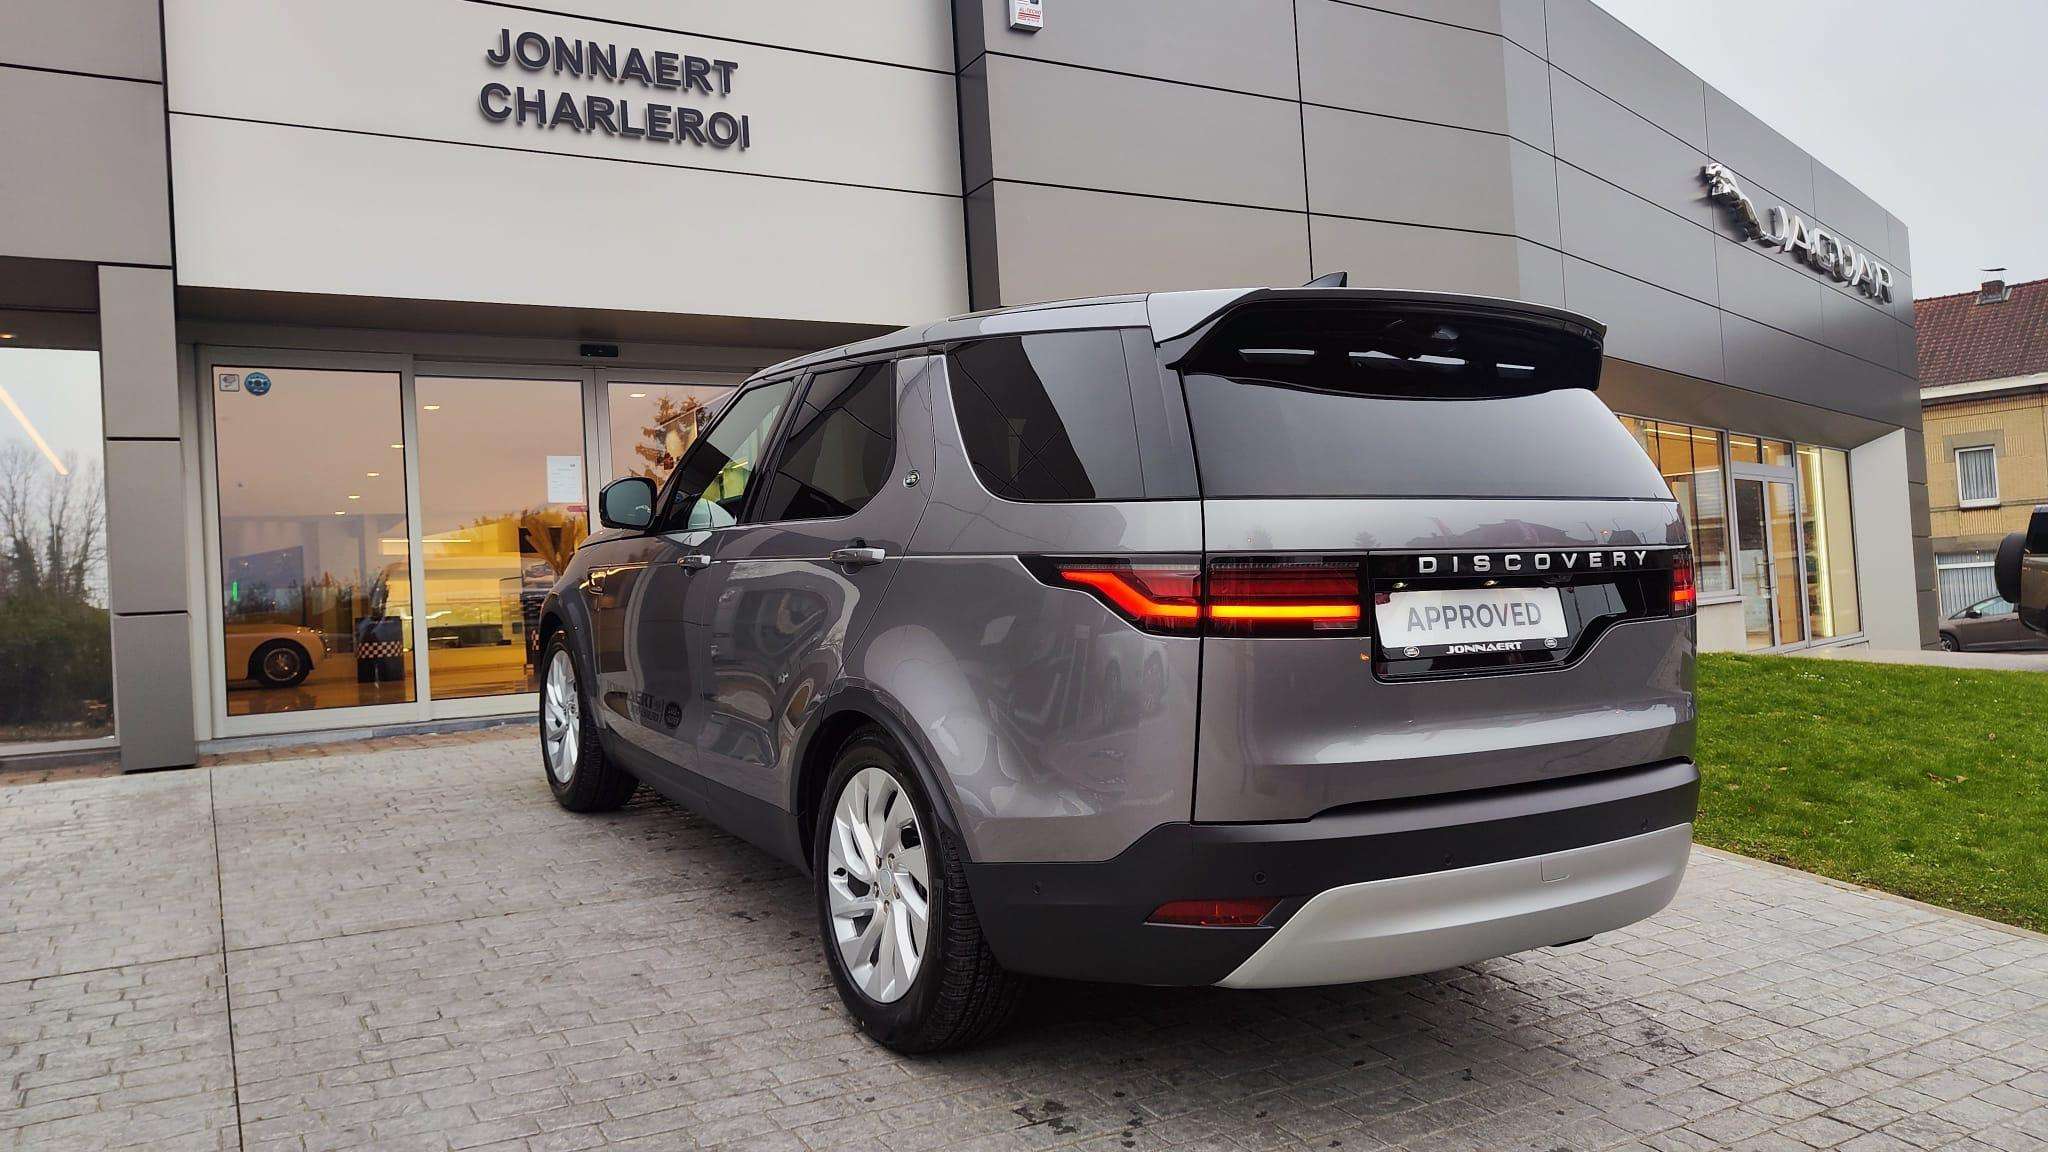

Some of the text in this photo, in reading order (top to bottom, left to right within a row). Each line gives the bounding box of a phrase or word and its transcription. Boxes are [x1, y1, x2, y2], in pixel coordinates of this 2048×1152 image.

[487, 28, 739, 96] JONNAERT
[479, 82, 751, 150] CHARLEROI
[1764, 205, 1894, 304] JAGUAR
[1418, 551, 1647, 573] DISCOVERY
[1407, 602, 1542, 631] APPROVED
[1445, 641, 1523, 655] JONNAERT
